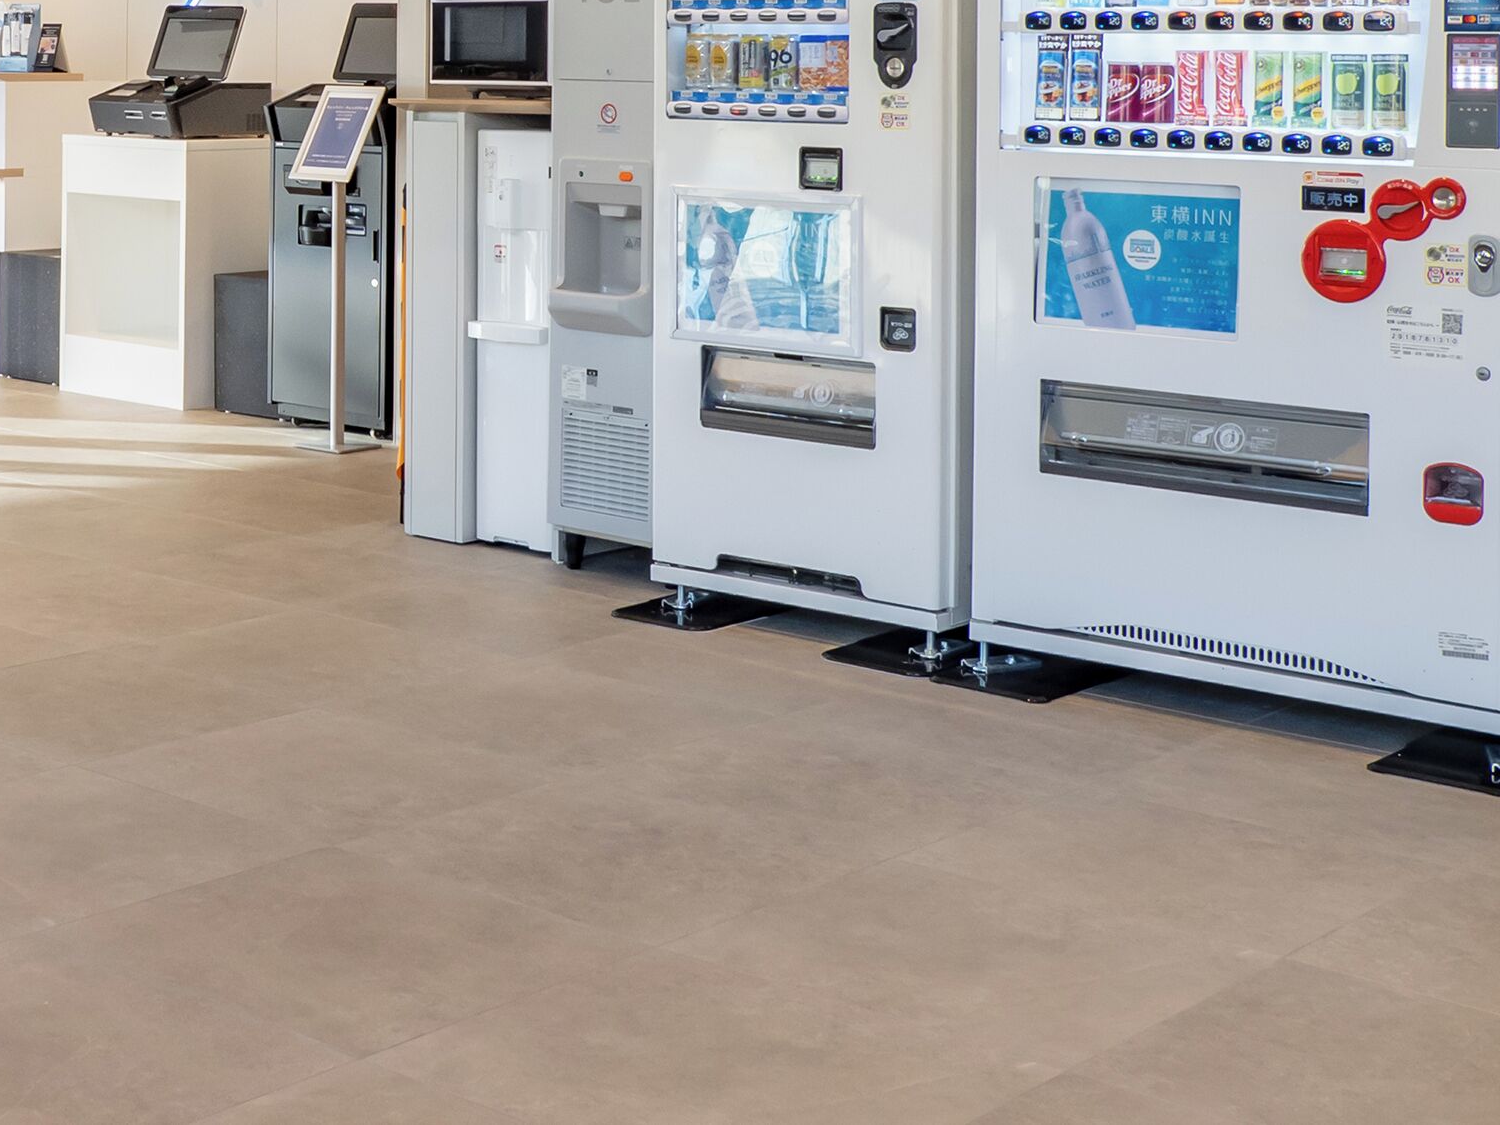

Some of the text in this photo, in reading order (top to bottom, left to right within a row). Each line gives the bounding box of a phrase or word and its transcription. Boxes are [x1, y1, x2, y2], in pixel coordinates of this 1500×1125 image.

[770, 48, 793, 68] 96
[1310, 191, 1359, 208] 販売中
[1150, 204, 1232, 227] 東横INN
[1163, 228, 1229, 244] 炭酸水誕生
[1083, 277, 1112, 290] WATER
